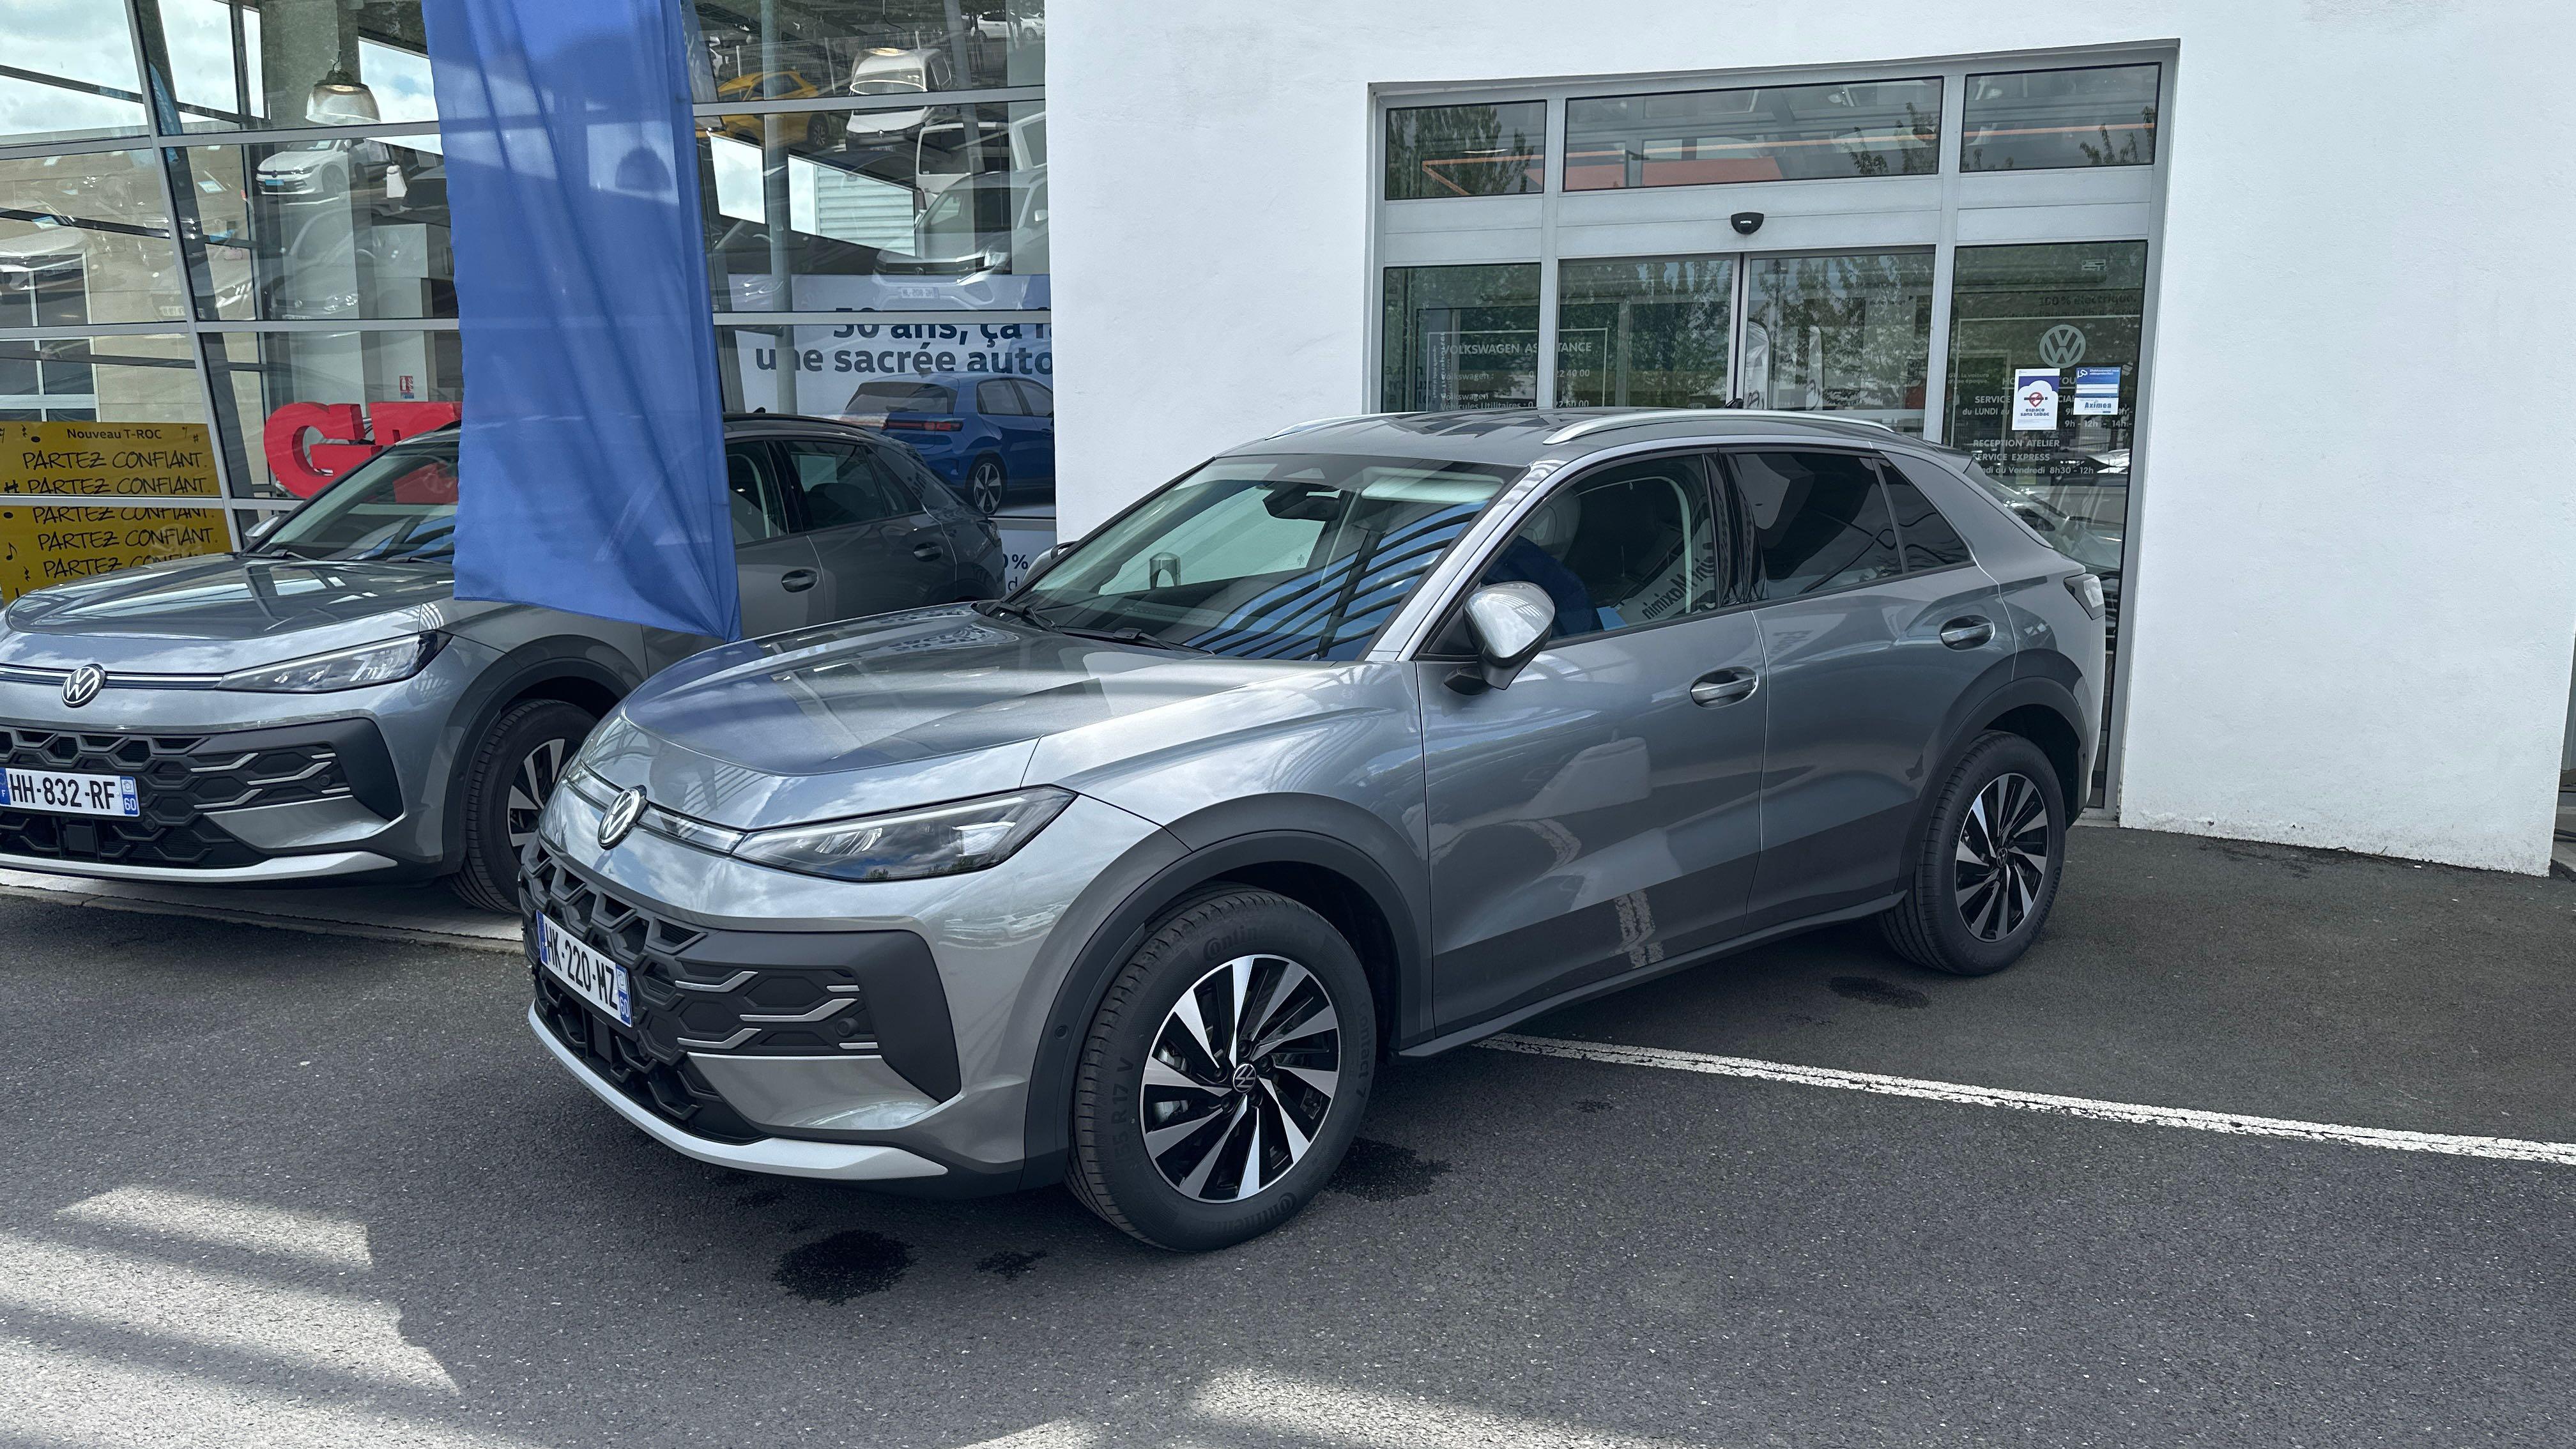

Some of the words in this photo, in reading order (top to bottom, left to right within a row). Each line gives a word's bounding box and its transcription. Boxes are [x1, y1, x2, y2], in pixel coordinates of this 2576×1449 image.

[1445, 343, 1520, 355] VOLKSWAGEN
[1525, 342, 1592, 353] ASTANCE
[834, 342, 956, 373] sacrée
[967, 348, 1052, 375] auto
[1975, 395, 2011, 404] SERVICE
[67, 429, 121, 440] Nouveau
[124, 429, 162, 440] T-ROC
[23, 450, 107, 470] PARTEZ
[112, 450, 208, 470] CONFIANT.
[2050, 466, 2071, 474] 8h30
[27, 477, 111, 494] PARTEZ
[117, 476, 211, 494] CONFIANT.
[33, 507, 115, 525] PARTEZ
[38, 531, 119, 551] PARTEZ
[125, 526, 218, 546] CONFIANT.
[43, 557, 123, 578] PARTEZ
[10, 773, 116, 809] HH-832-RF
[124, 797, 137, 811] 60
[546, 923, 618, 1011] HK-220-MZ
[620, 997, 629, 1018] 60
